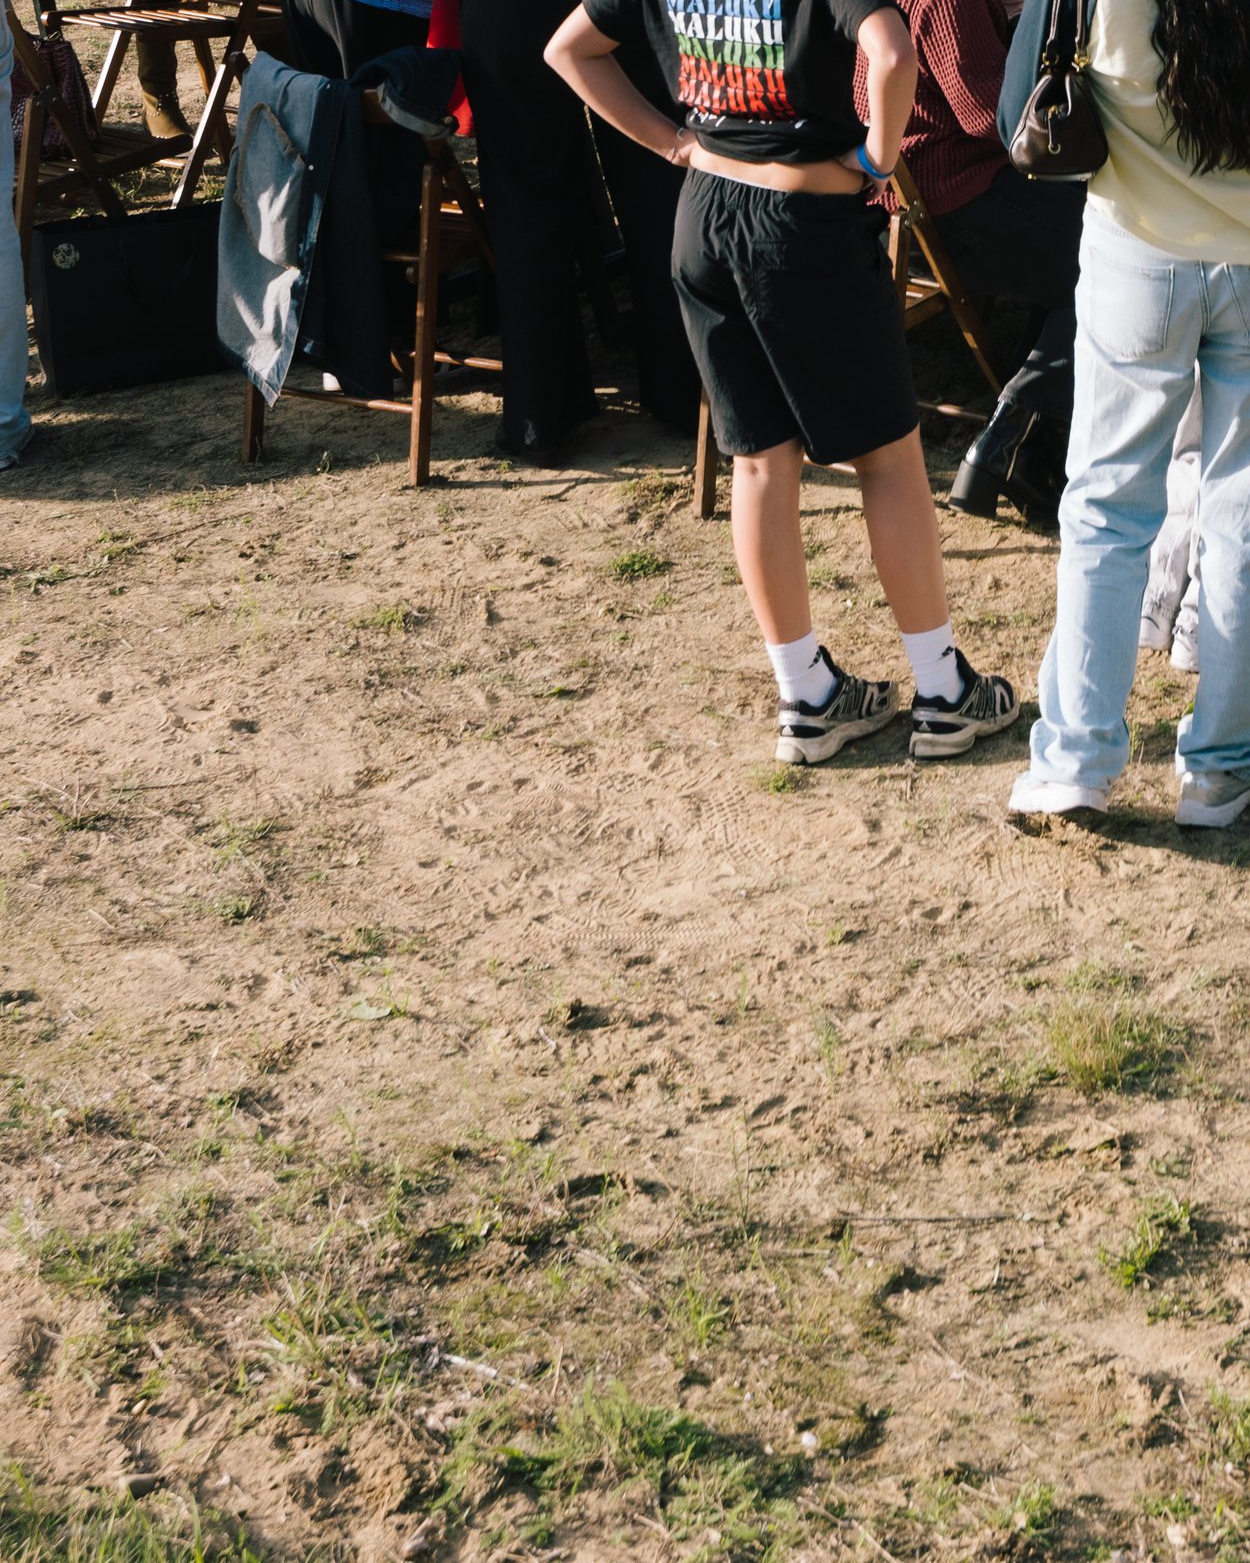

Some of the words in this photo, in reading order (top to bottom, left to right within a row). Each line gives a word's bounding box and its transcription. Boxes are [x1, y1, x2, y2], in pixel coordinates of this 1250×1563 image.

[668, 10, 785, 46] MALUKU
[676, 33, 785, 71] MALUKU
[679, 53, 787, 94] MALUKU
[678, 77, 795, 113] MALUKU
